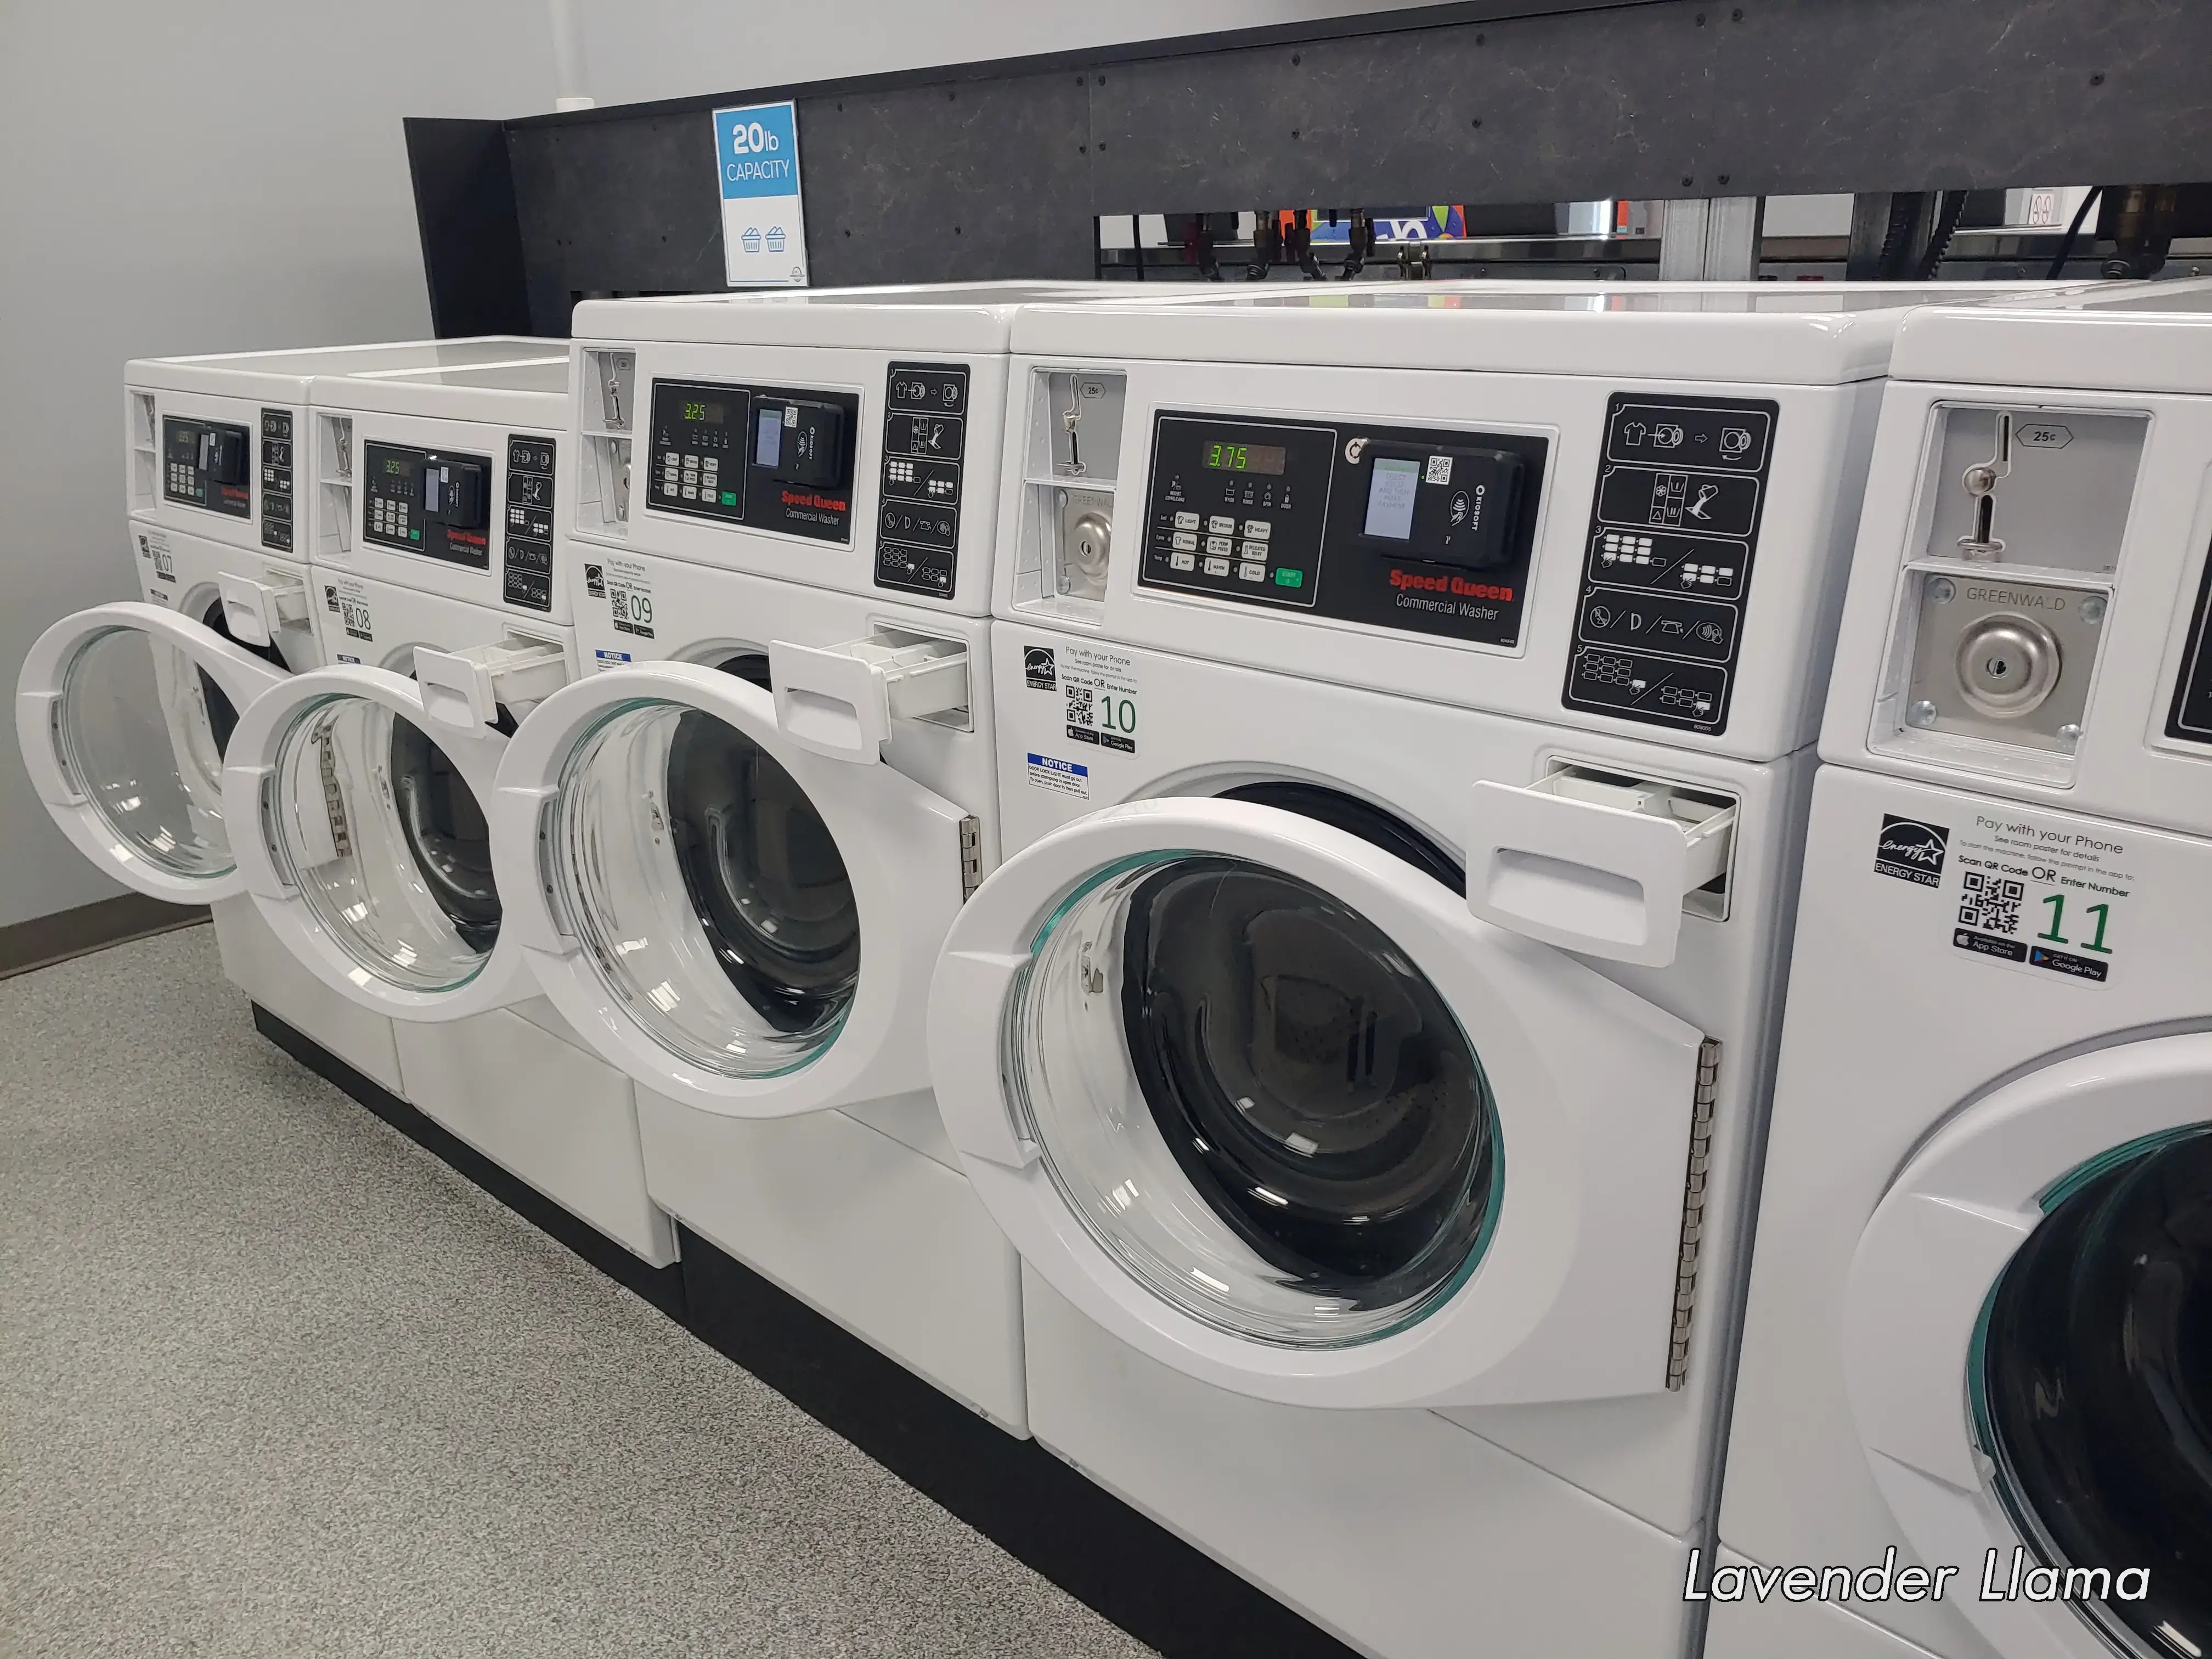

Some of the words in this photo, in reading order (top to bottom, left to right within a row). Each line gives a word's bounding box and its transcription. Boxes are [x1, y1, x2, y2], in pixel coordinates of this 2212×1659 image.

[732, 122, 779, 154] 20lb
[726, 159, 790, 181] CAPACITY
[1209, 444, 1247, 469] 3.75
[1604, 465, 1611, 473] 2
[782, 490, 812, 506] Speed
[814, 495, 846, 511] Queen
[786, 507, 817, 522] Commercial
[819, 512, 840, 526] Washer
[1471, 496, 1482, 531] KIOSOFT
[1595, 525, 1601, 533] 3
[1389, 569, 1448, 591] Speed
[1451, 577, 1513, 601] Queen
[631, 595, 652, 623] 09
[1396, 593, 1455, 614] Commercial
[1459, 602, 1499, 620] Washer
[356, 607, 371, 630] 08
[603, 651, 623, 661] NOTICE
[1066, 646, 1077, 657] Pay
[1079, 650, 1092, 658] with
[1109, 655, 1130, 665] Phone
[1094, 678, 1105, 688] OR
[1119, 686, 1137, 695] Number
[1101, 696, 1136, 733] 10
[1111, 741, 1124, 749] Google
[1042, 758, 1073, 772] NOTICE
[1977, 816, 2003, 832] Pay
[2006, 824, 2035, 837] with
[2040, 830, 2072, 843] your
[2075, 835, 2123, 854] Phone
[1995, 835, 2009, 844] See
[2011, 840, 2032, 848] room
[2034, 844, 2058, 853] poster
[2061, 848, 2072, 857] for
[2073, 851, 2101, 862] details
[2027, 854, 2046, 862] follow
[2061, 861, 2086, 871] prompt
[1875, 862, 1913, 879] ENERGY
[1913, 873, 1939, 887] STAR
[1958, 855, 1981, 866] Scan
[1984, 861, 1999, 870] QR
[2001, 864, 2028, 876] Code
[2032, 867, 2056, 882] OR
[2061, 876, 2086, 888] Enter
[2088, 882, 2130, 898] Number
[2037, 894, 2113, 954] 11
[1973, 941, 1989, 951] App
[1991, 945, 2013, 956] Store
[2052, 960, 2083, 972] Google
[2084, 966, 2102, 978] Play
